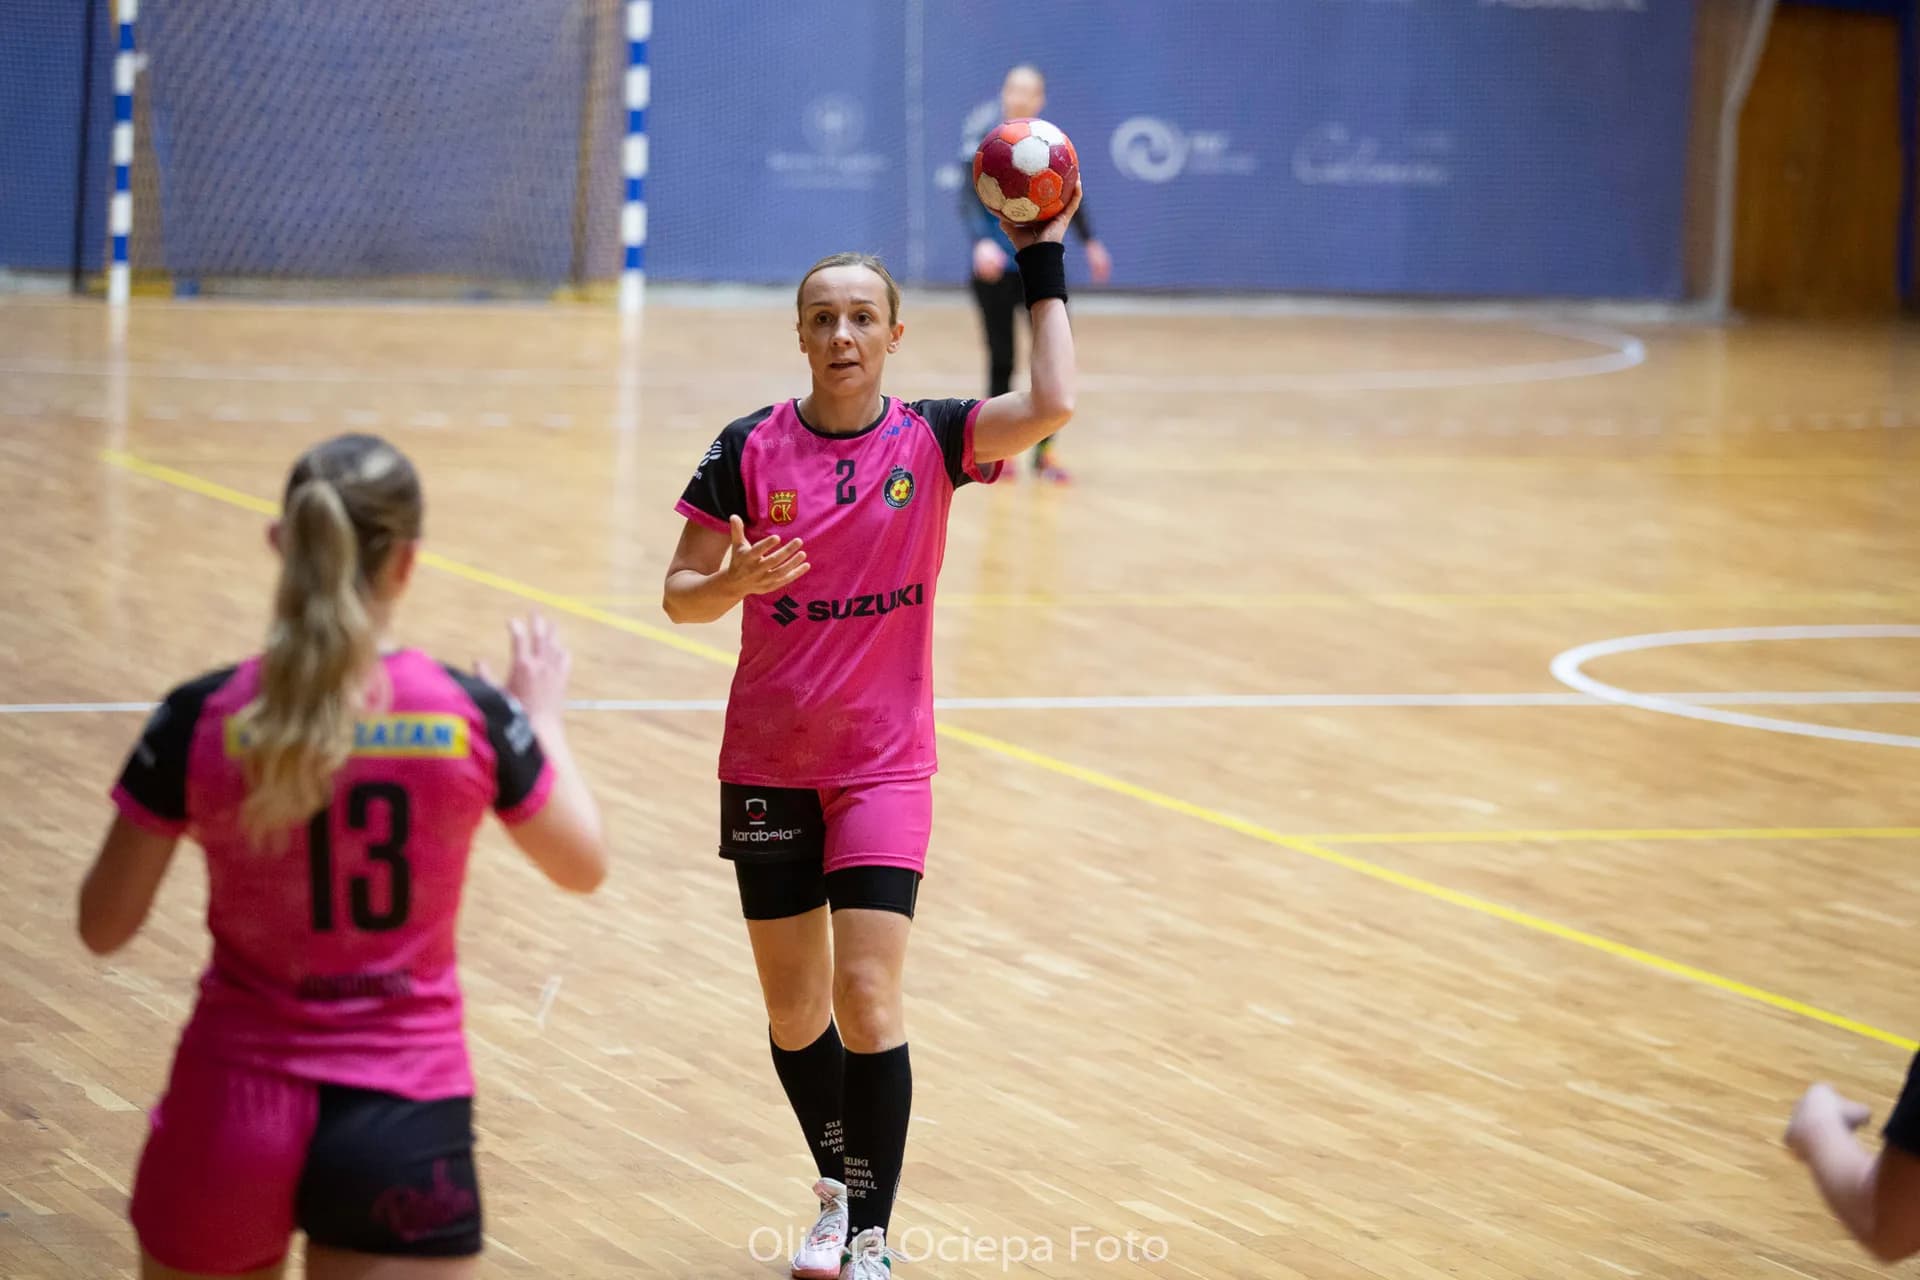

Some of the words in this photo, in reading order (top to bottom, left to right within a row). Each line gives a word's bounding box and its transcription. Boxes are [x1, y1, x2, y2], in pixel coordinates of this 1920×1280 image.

[835, 459, 857, 505] 2
[771, 504, 792, 522] CK
[807, 583, 923, 622] SUZUKI
[308, 781, 412, 932] 13
